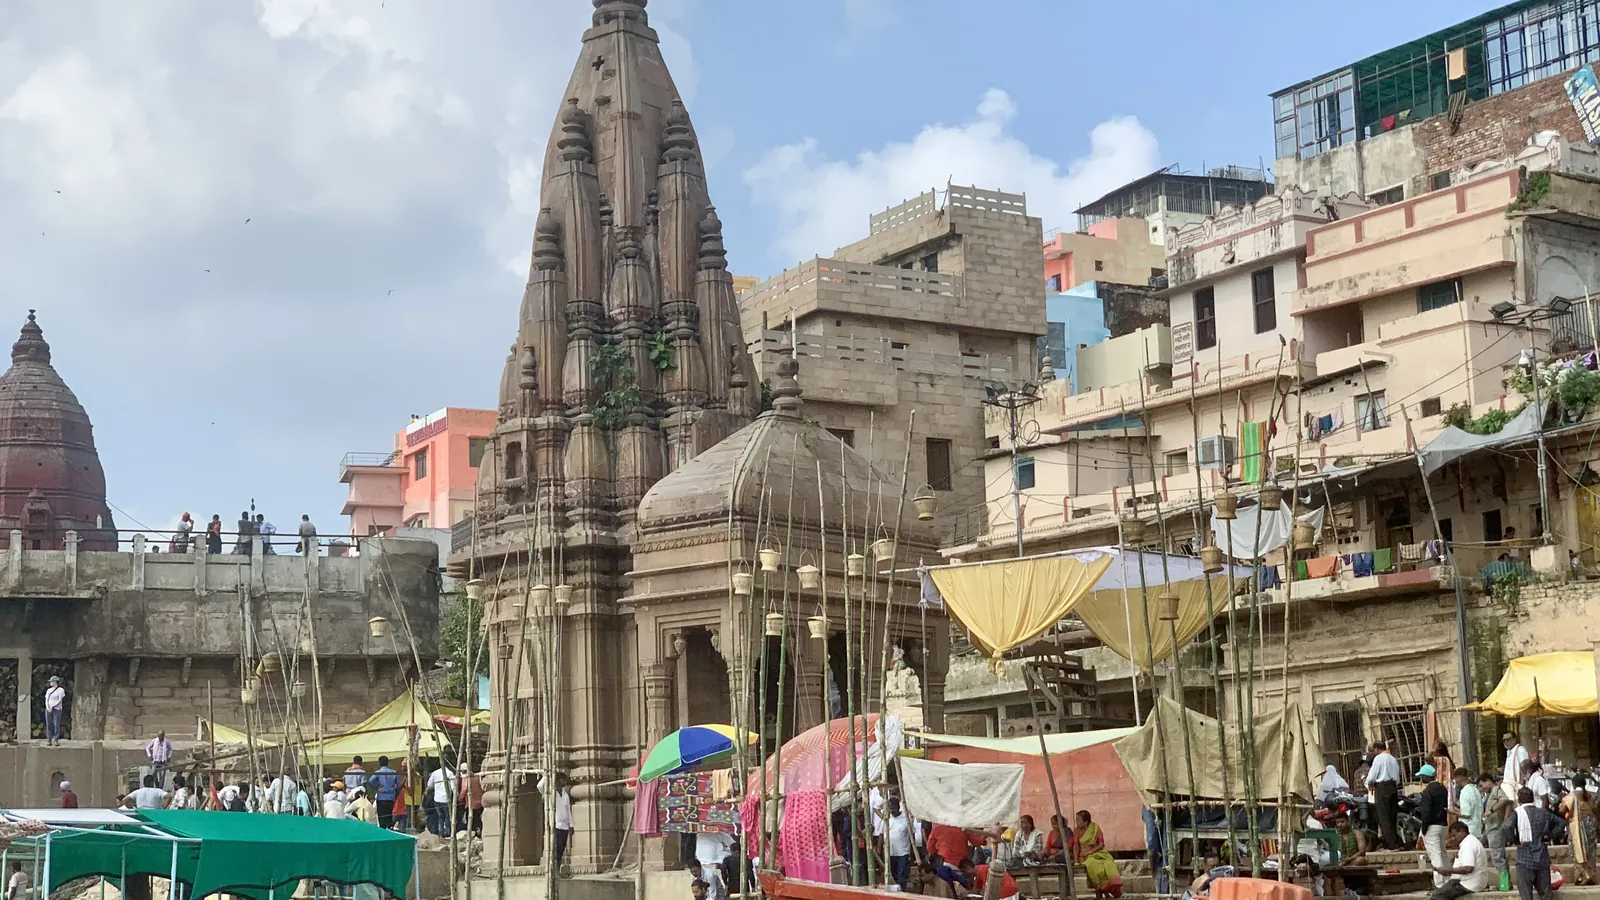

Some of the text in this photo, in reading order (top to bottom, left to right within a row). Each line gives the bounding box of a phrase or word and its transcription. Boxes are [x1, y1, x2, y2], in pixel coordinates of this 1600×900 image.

[1573, 99, 1596, 143] GUEST HOUSE
[1580, 84, 1600, 138] KAS
